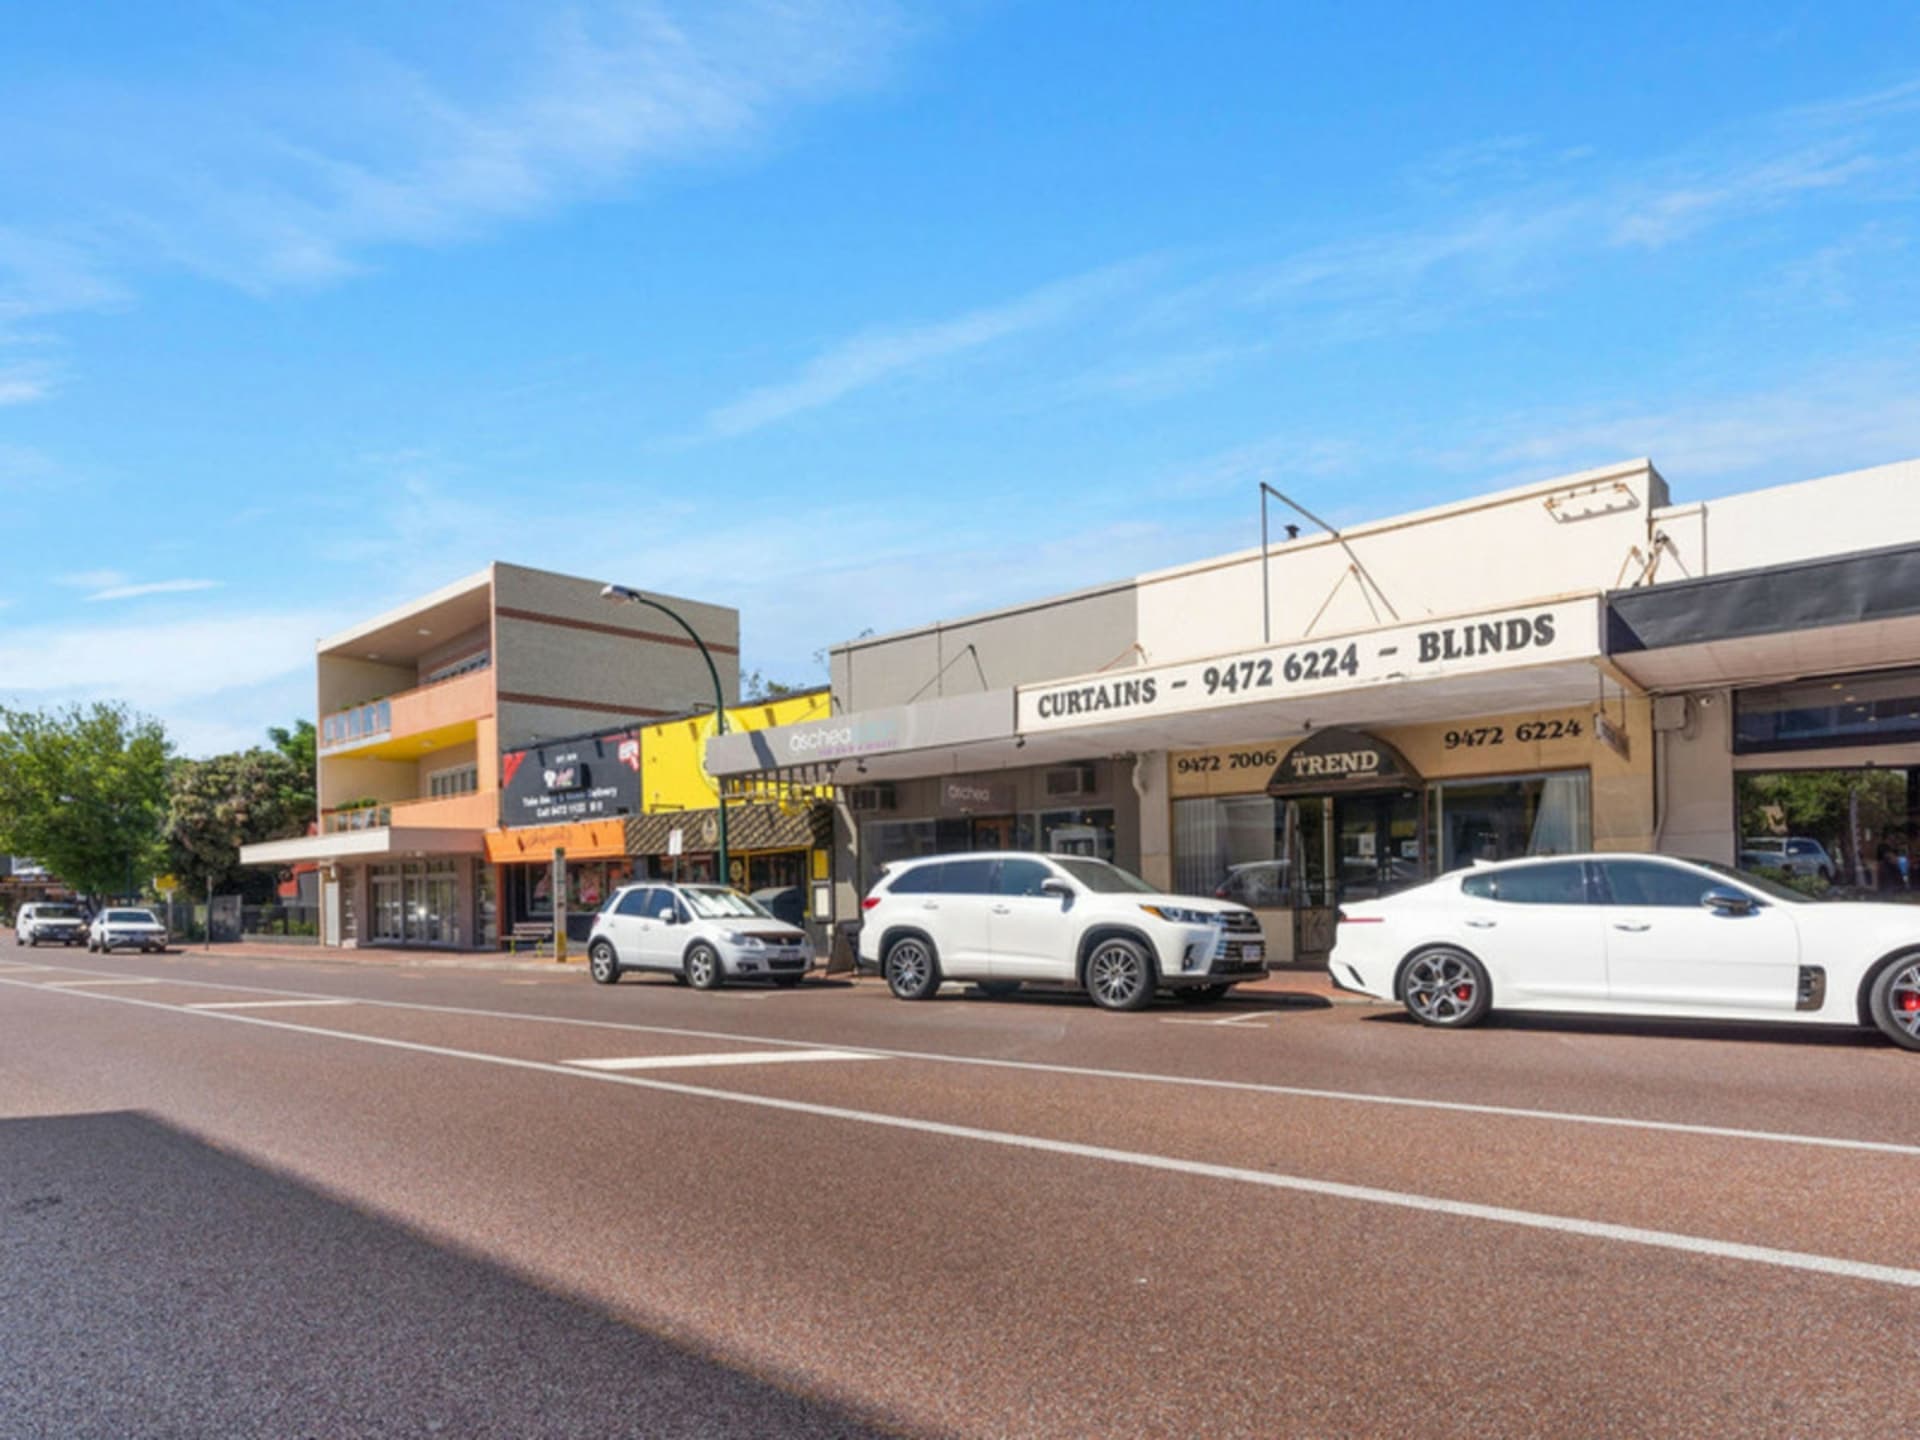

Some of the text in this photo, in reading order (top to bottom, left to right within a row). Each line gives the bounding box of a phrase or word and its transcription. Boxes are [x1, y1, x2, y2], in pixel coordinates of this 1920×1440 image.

[1038, 677, 1157, 718] CURTAINS
[1203, 658, 1273, 695] 9472
[1283, 642, 1359, 682] 6224
[1418, 613, 1555, 663] BLINDS
[1444, 726, 1504, 749] 9472
[1515, 719, 1583, 742] 6224
[1177, 750, 1278, 774] 9472 7006
[1291, 750, 1379, 776] TREND
